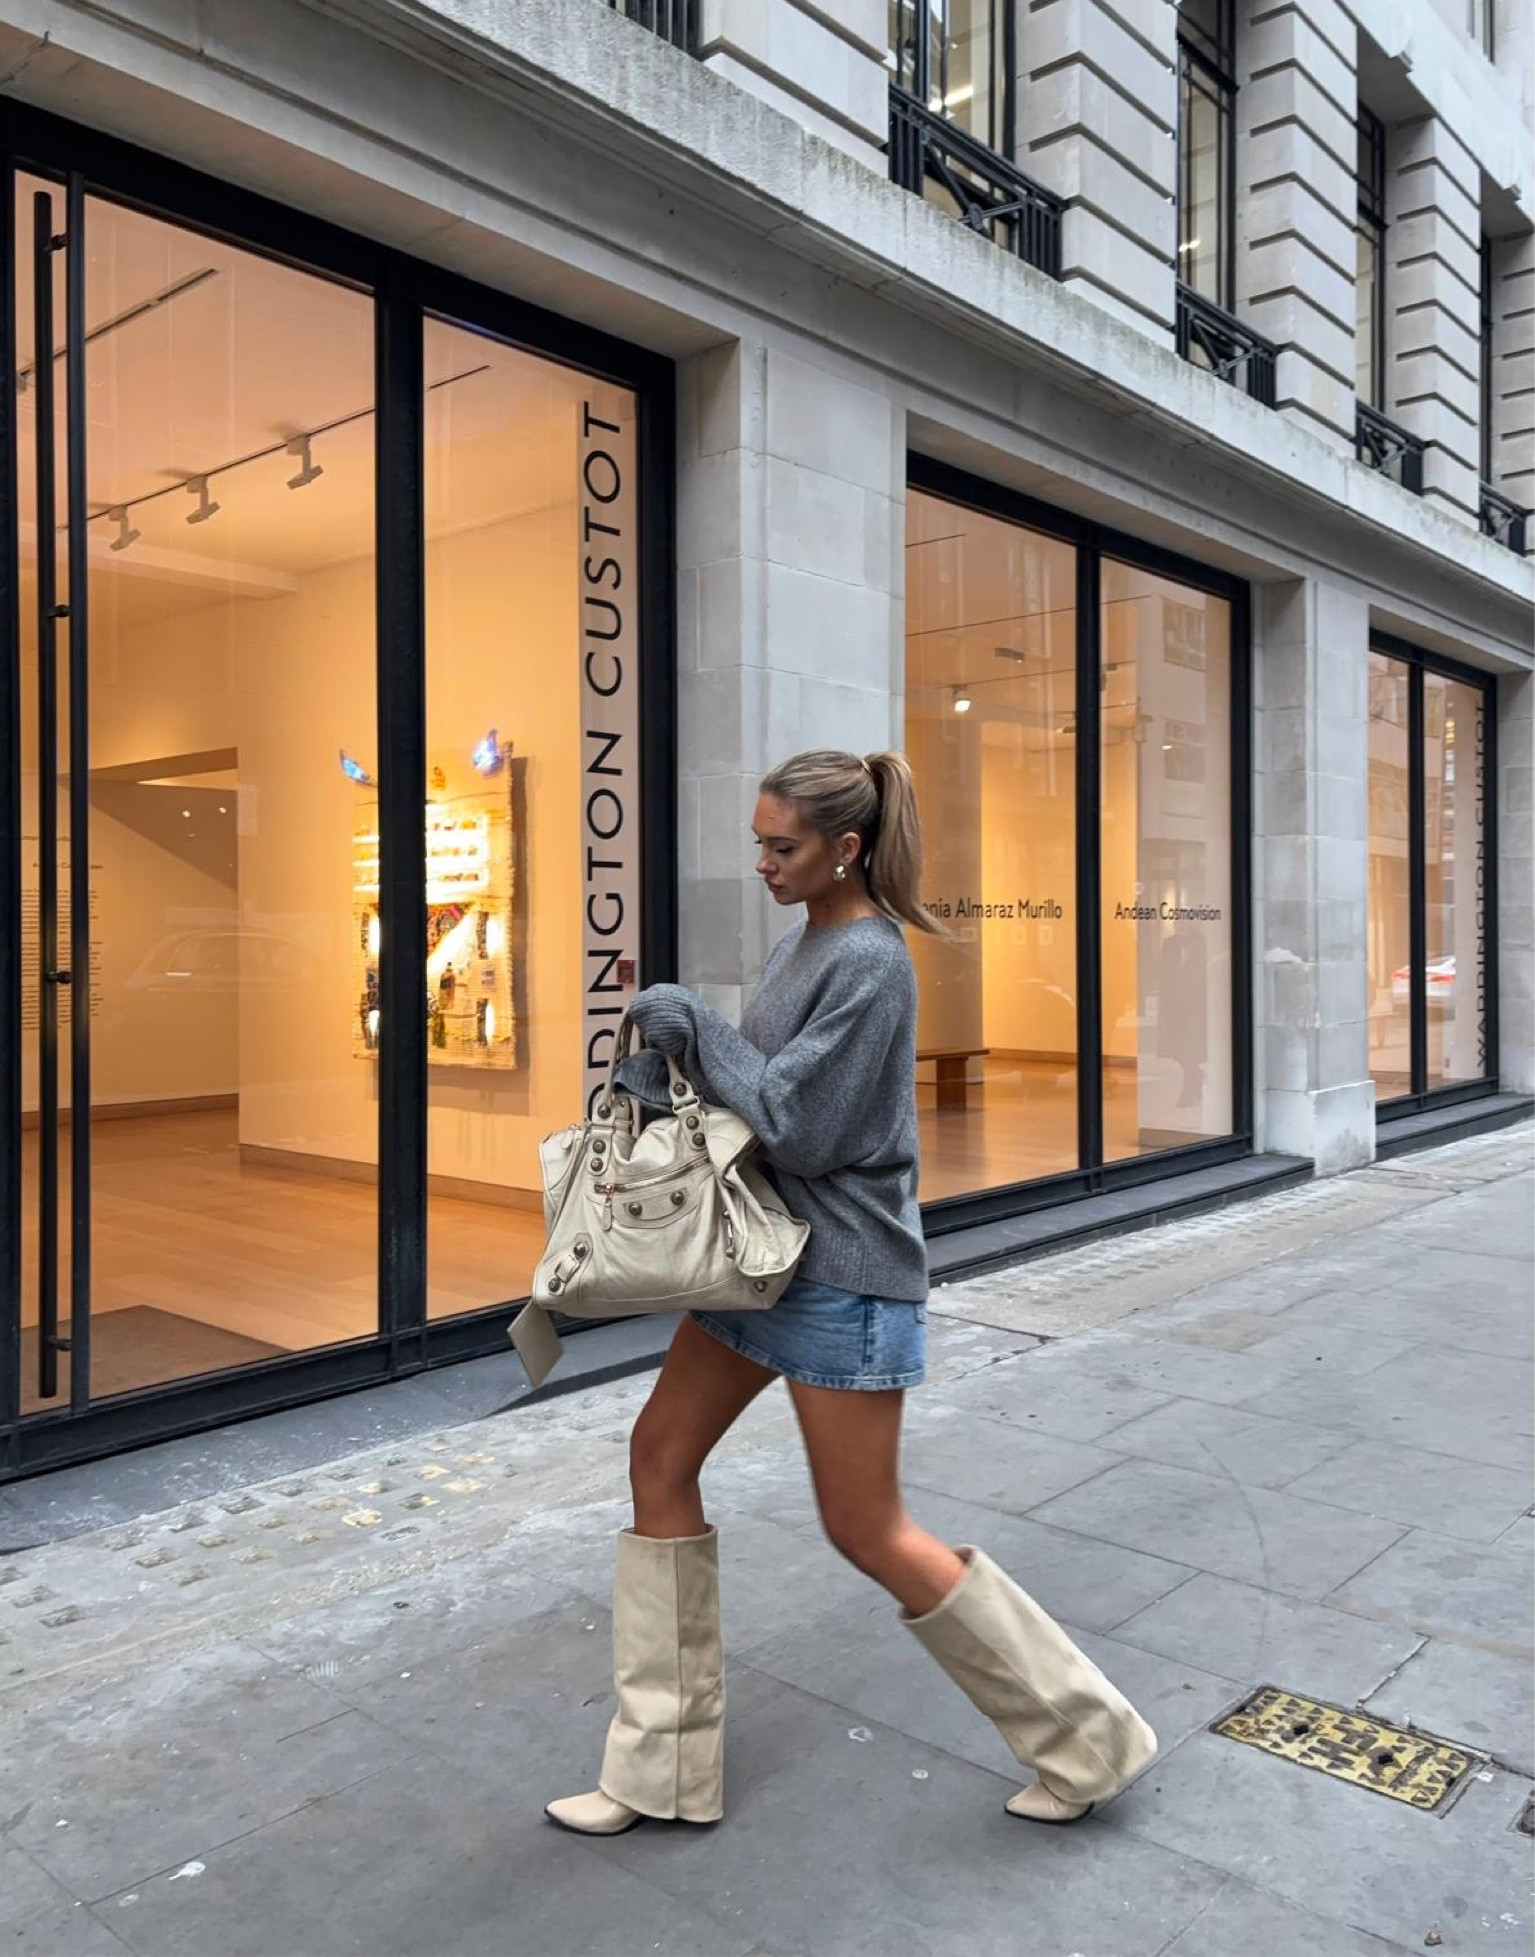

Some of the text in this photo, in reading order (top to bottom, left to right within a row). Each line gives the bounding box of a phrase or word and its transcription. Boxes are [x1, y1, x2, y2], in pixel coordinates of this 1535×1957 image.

[584, 401, 623, 696] CUSTOT
[955, 897, 1013, 918] Almaraz
[1017, 899, 1063, 918] Murillo
[1115, 901, 1222, 920] Andean Cosmovision
